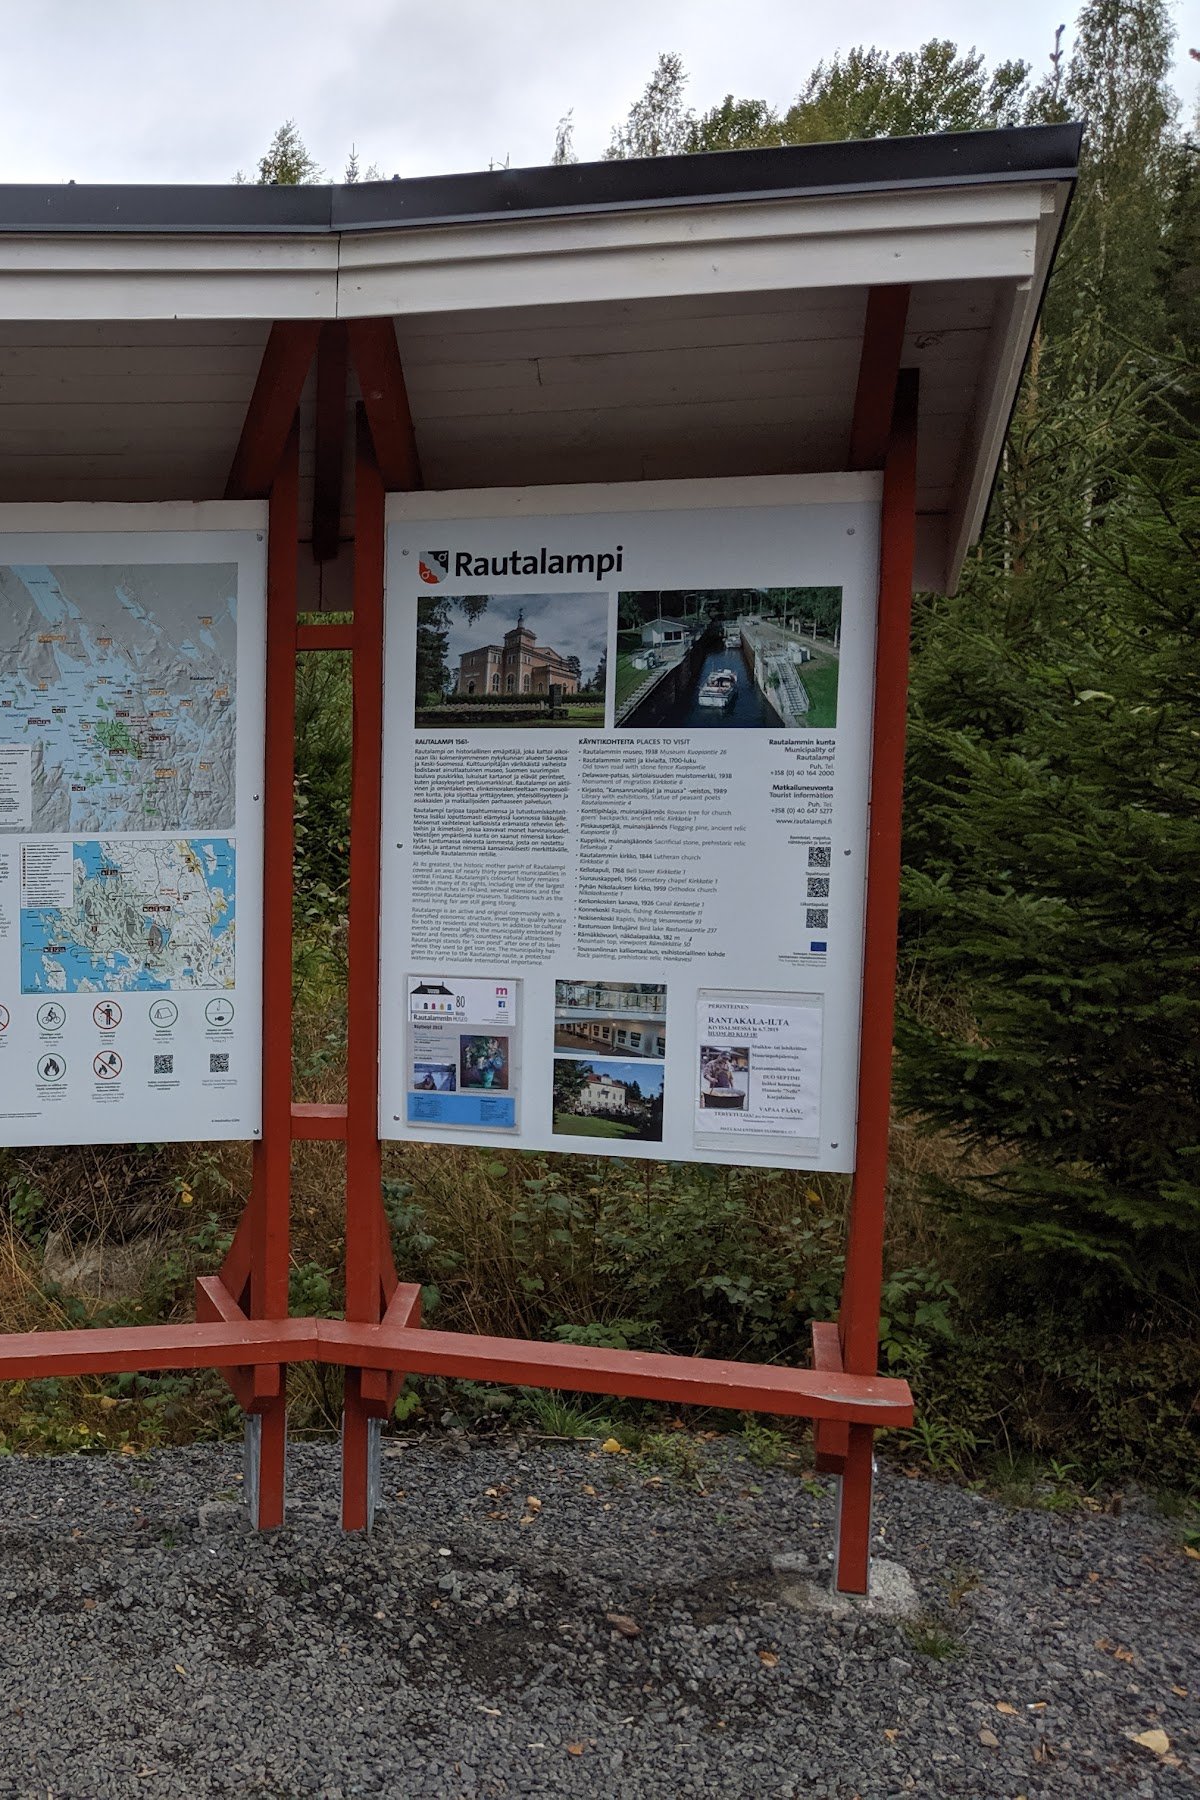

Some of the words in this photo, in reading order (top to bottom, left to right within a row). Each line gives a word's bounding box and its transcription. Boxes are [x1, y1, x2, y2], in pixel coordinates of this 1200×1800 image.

[455, 546, 624, 580] Rautalampi
[456, 996, 465, 1008] 80
[708, 1016, 789, 1026] RANTAKALA-ILTA
